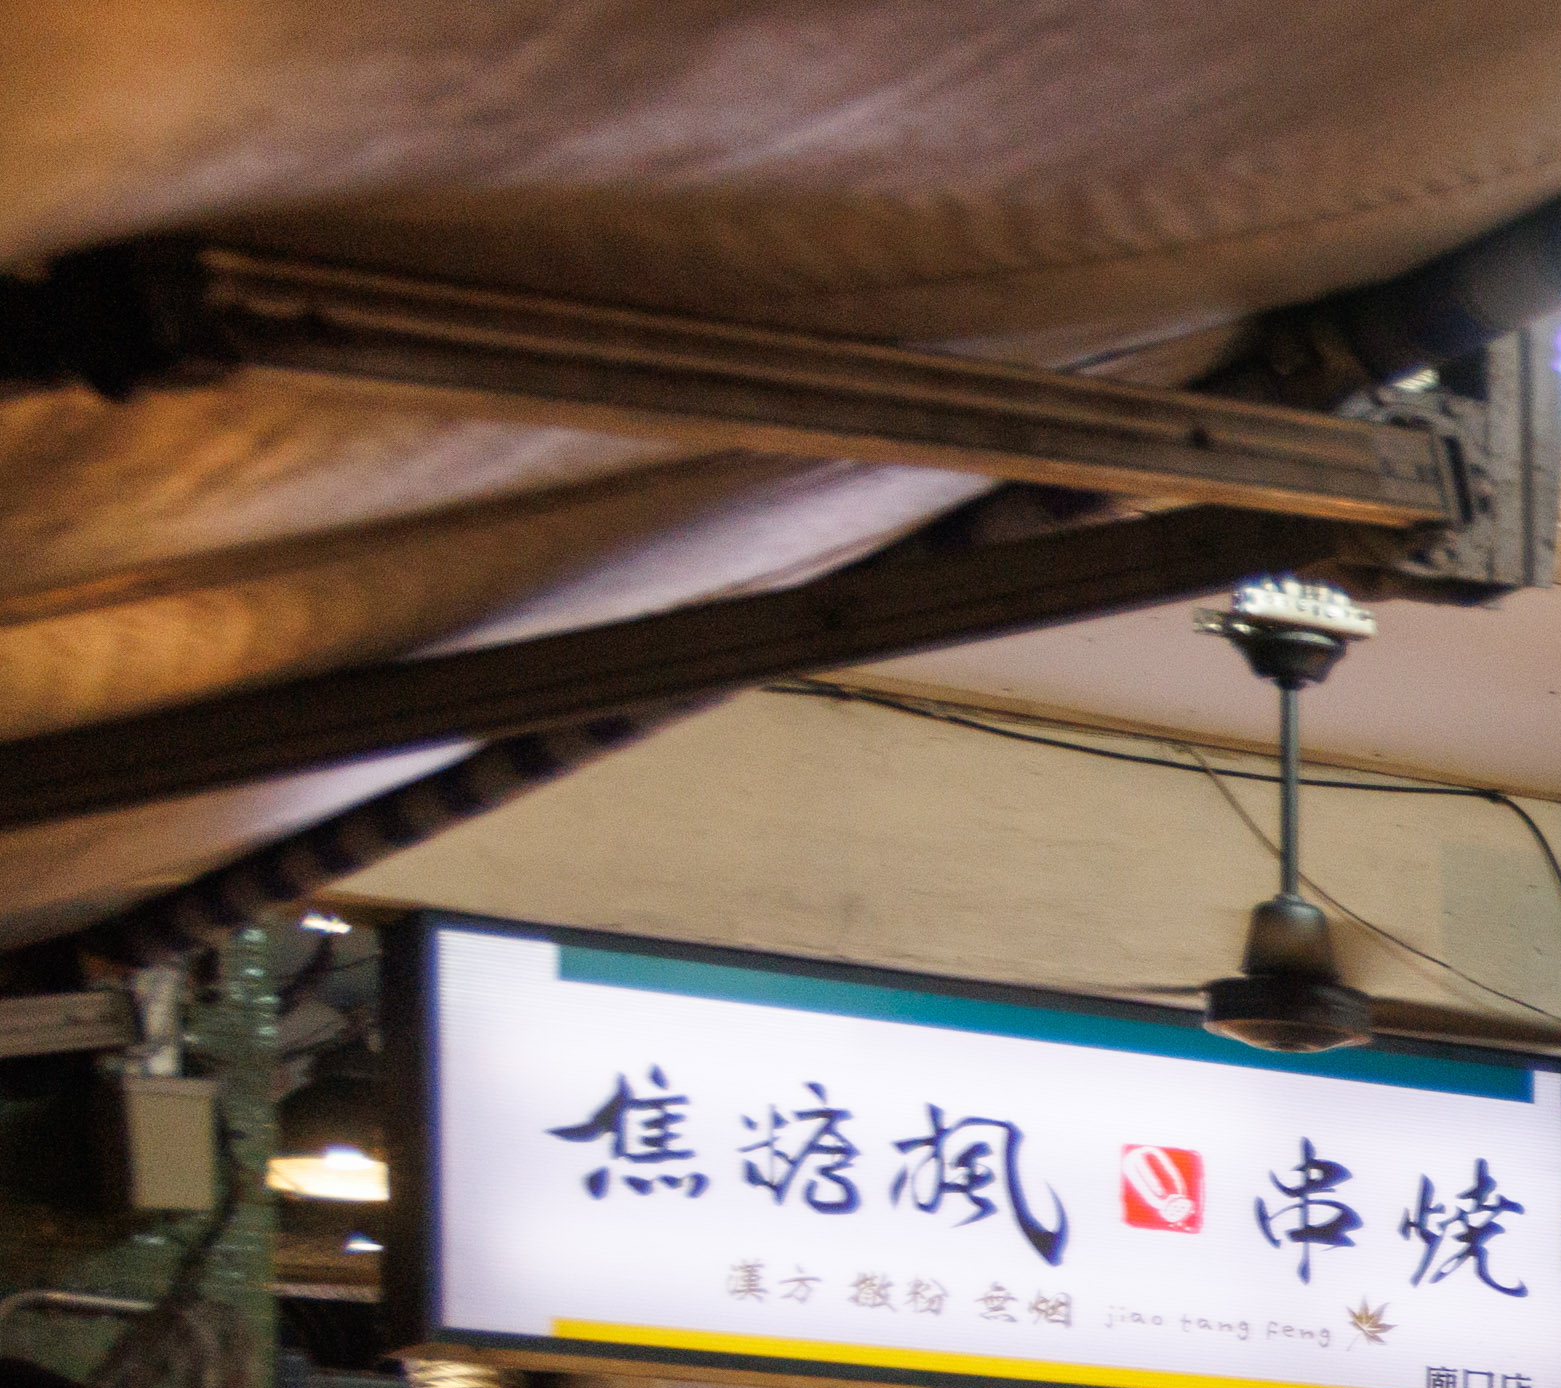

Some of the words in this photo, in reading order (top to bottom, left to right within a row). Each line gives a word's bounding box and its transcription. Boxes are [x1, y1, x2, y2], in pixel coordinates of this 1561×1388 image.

[543, 1065, 1067, 1268] 焦糖楓
[1252, 1137, 1530, 1300] 串燒
[1105, 1304, 1165, 1330] jiao
[1180, 1312, 1250, 1342] tang
[1265, 1319, 1333, 1349] feng
